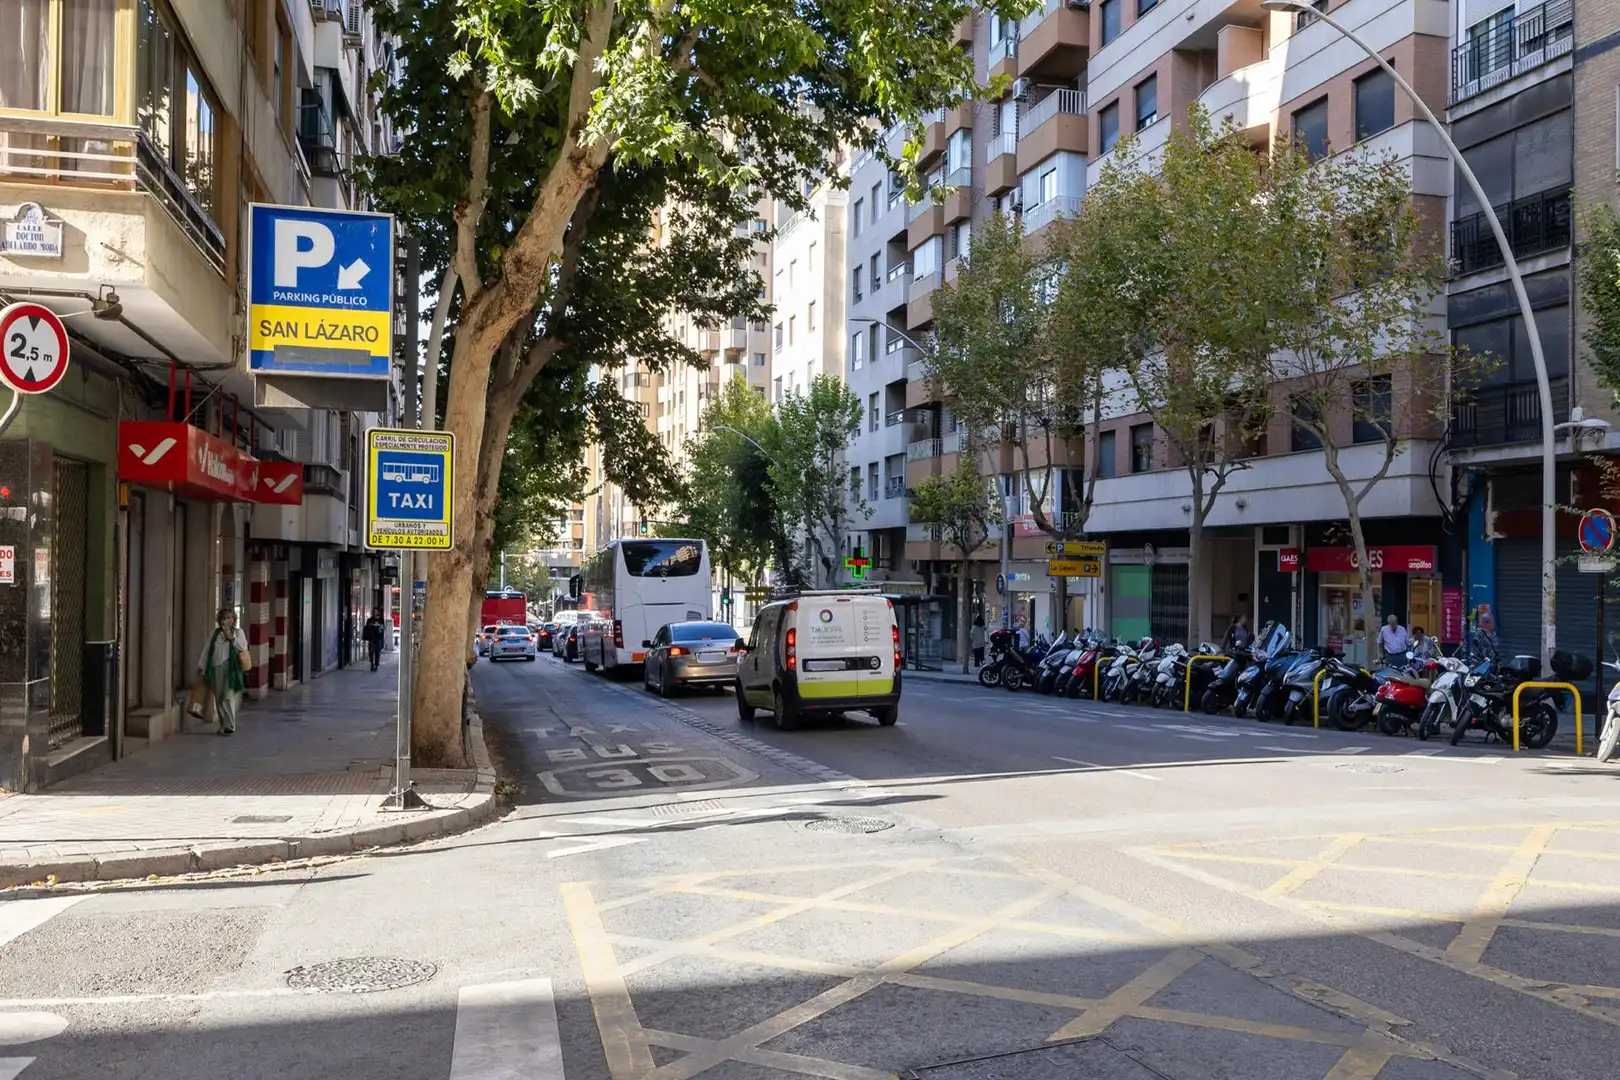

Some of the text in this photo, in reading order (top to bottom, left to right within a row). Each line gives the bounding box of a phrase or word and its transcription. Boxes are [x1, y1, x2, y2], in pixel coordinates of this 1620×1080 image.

[16, 232, 44, 241] DOCTOR
[274, 219, 335, 287] P
[273, 290, 368, 306] PARKING PÚBLICO
[260, 319, 379, 343] SAN LÁZARO
[10, 332, 53, 362] 2,5 m
[375, 441, 447, 451] ESPECIALMENTE PROTEGIDO
[388, 492, 433, 509] TAXI
[377, 526, 405, 534] VEHÍCULOS
[372, 535, 382, 543] DE
[385, 535, 403, 544] 7:30
[406, 536, 412, 544] A
[414, 536, 437, 545] 22:00
[1350, 550, 1383, 568] GES
[1408, 560, 1432, 570] amplifon
[524, 722, 661, 739] TAXI
[545, 742, 685, 763] BUS
[586, 764, 707, 788] 30
